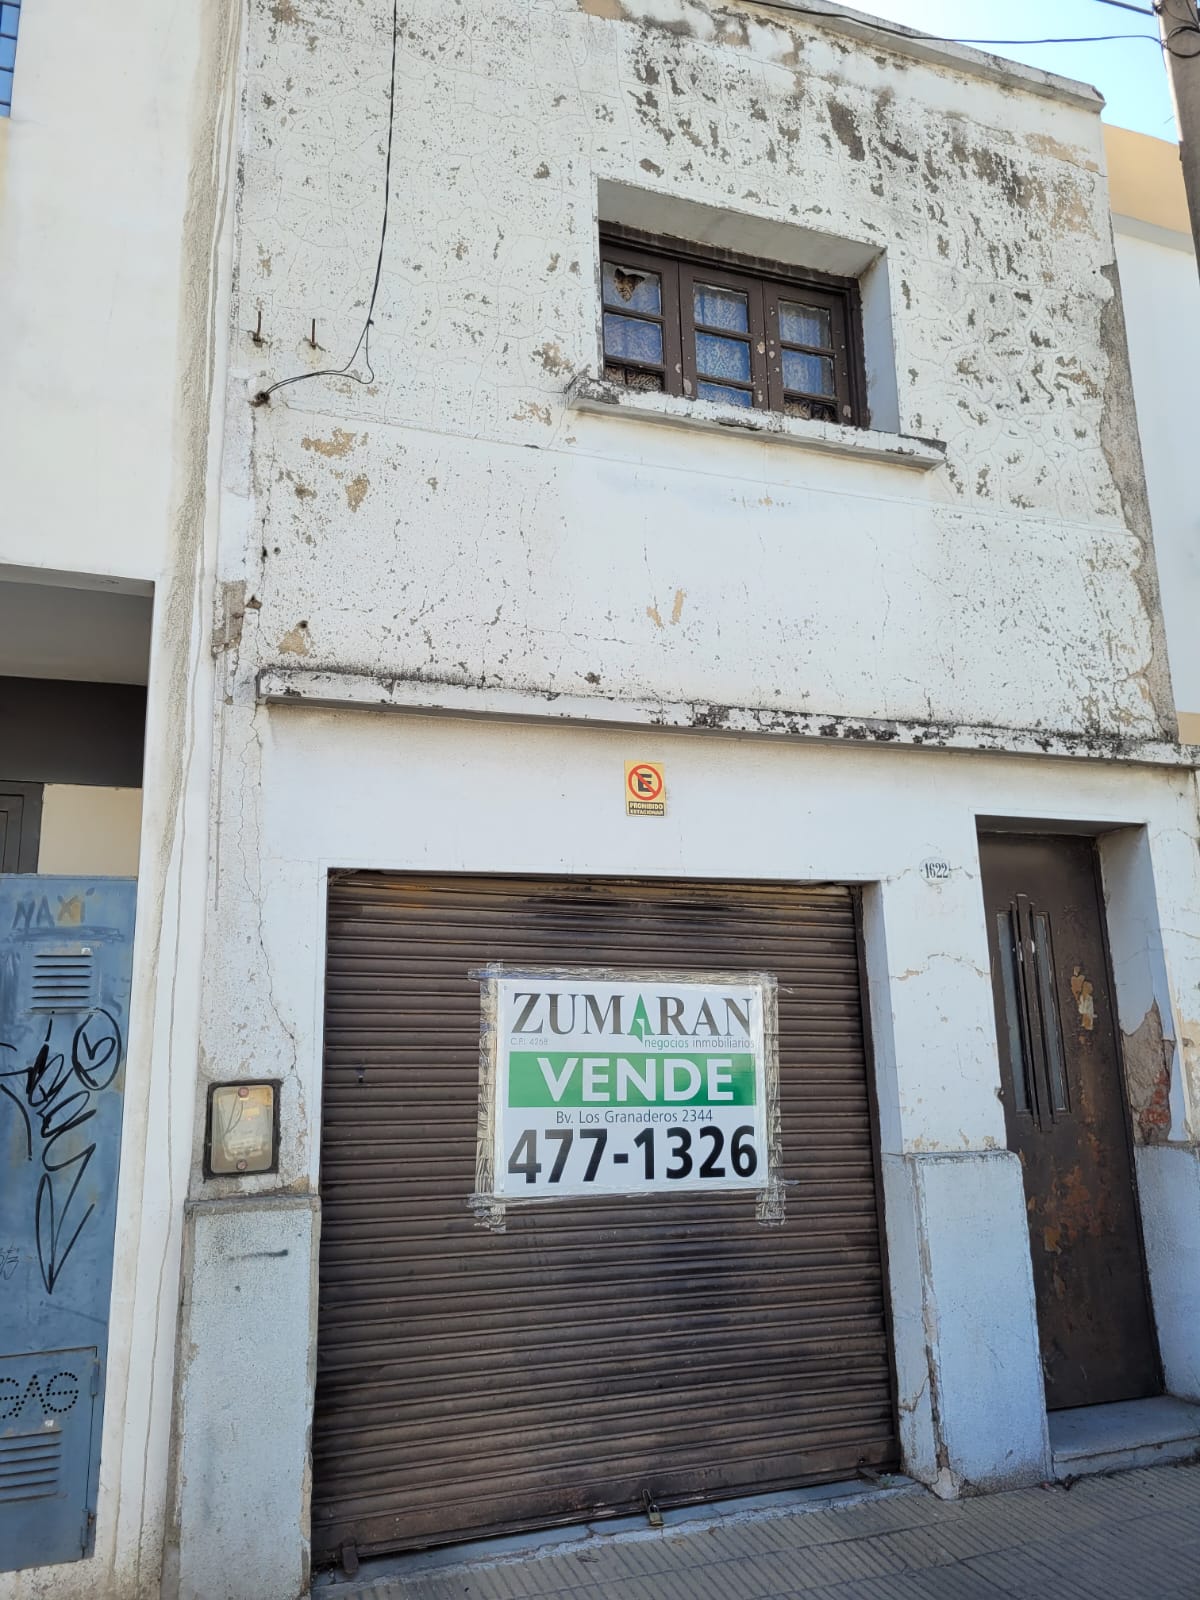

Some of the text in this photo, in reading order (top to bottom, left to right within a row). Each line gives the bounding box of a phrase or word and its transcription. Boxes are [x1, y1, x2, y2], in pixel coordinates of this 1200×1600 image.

[925, 862, 949, 879] 1622
[511, 993, 753, 1042] ZUMARAN
[644, 1036, 755, 1050] negocios inmobiliarios
[536, 1057, 734, 1102] VENDE
[556, 1109, 713, 1124] Bv. Los Granaderos 2344
[507, 1125, 758, 1184] 477-1326
